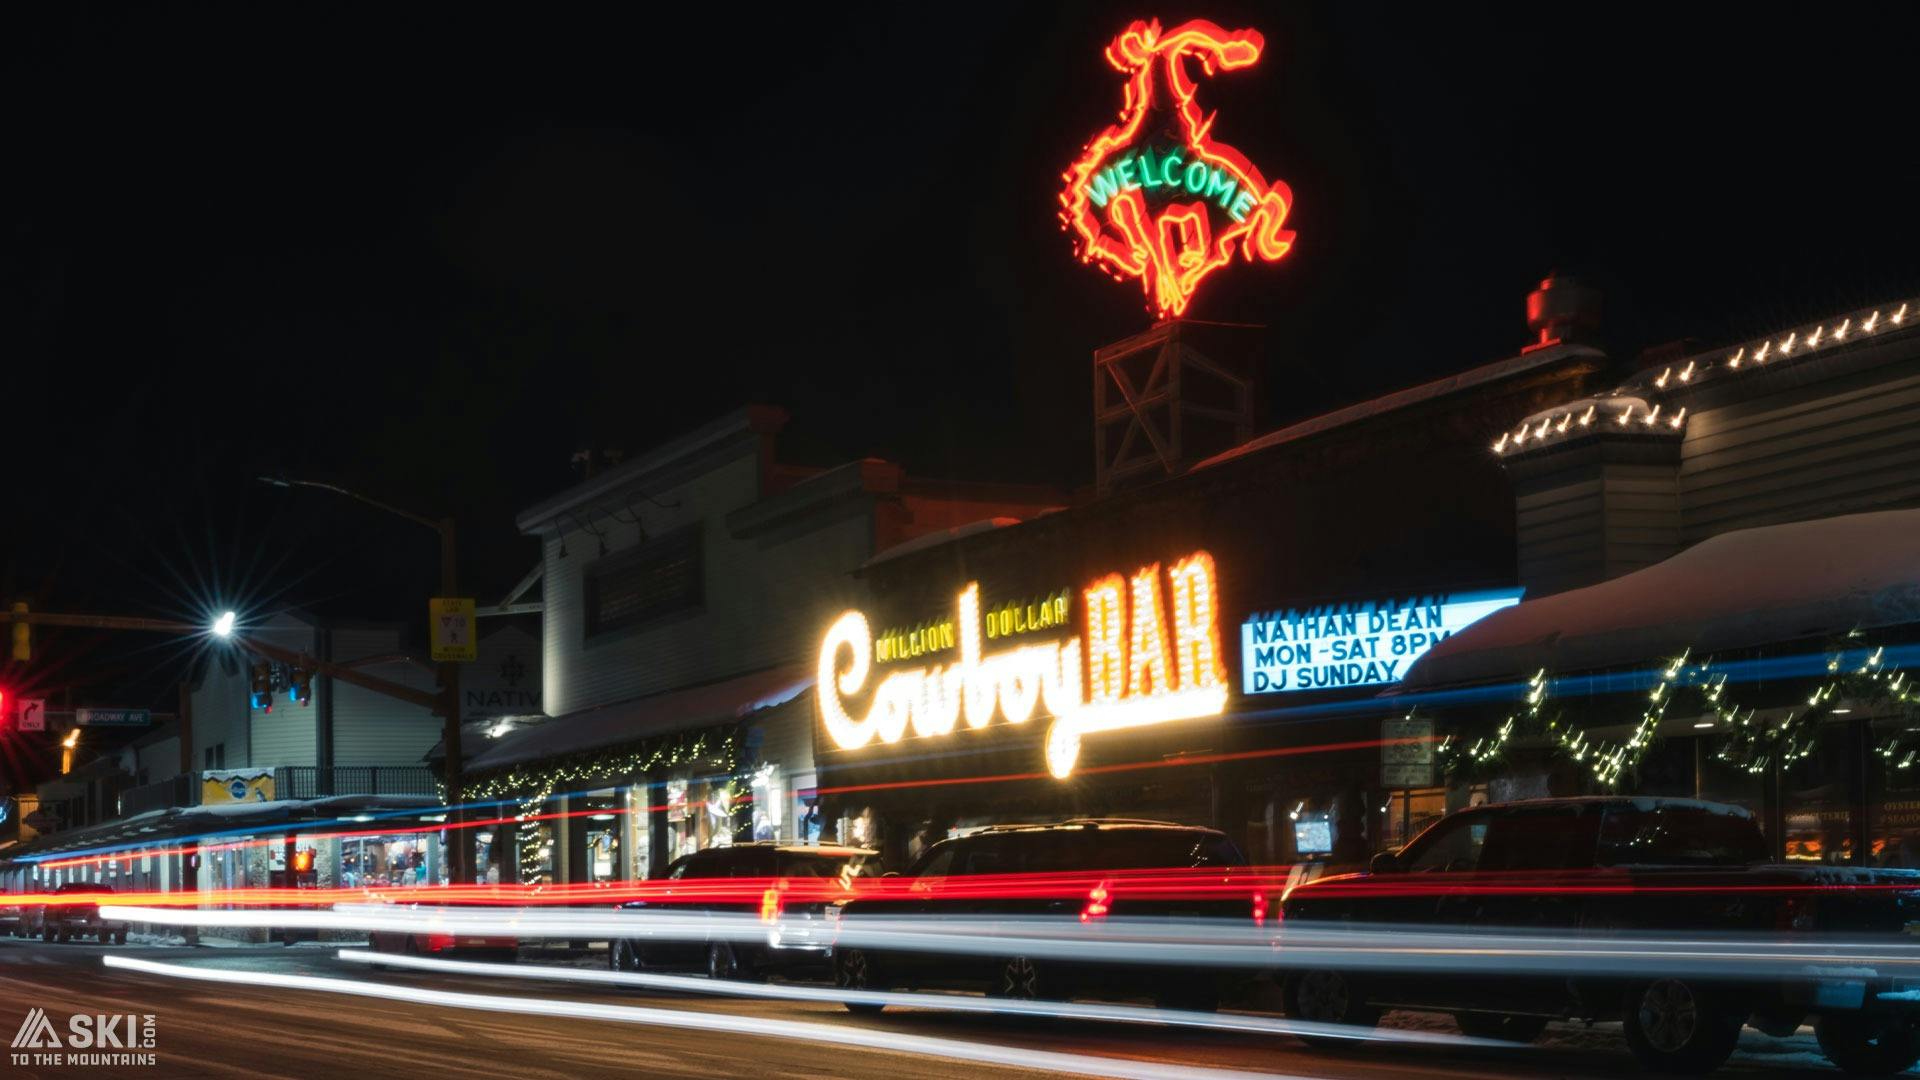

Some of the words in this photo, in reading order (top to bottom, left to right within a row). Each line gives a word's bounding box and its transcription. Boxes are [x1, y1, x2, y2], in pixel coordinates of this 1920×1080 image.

[1085, 153, 1258, 223] WELCOME
[876, 623, 954, 663] MILLION
[986, 597, 1068, 638] DOLLAR
[1252, 611, 1356, 645] NATHAN
[1368, 602, 1442, 632] DEAN
[817, 580, 1090, 779] Cowboy
[1084, 551, 1226, 698] BAR
[1253, 669, 1287, 692] DJ
[1296, 659, 1399, 688] SUNDAY
[1255, 643, 1311, 668] MON
